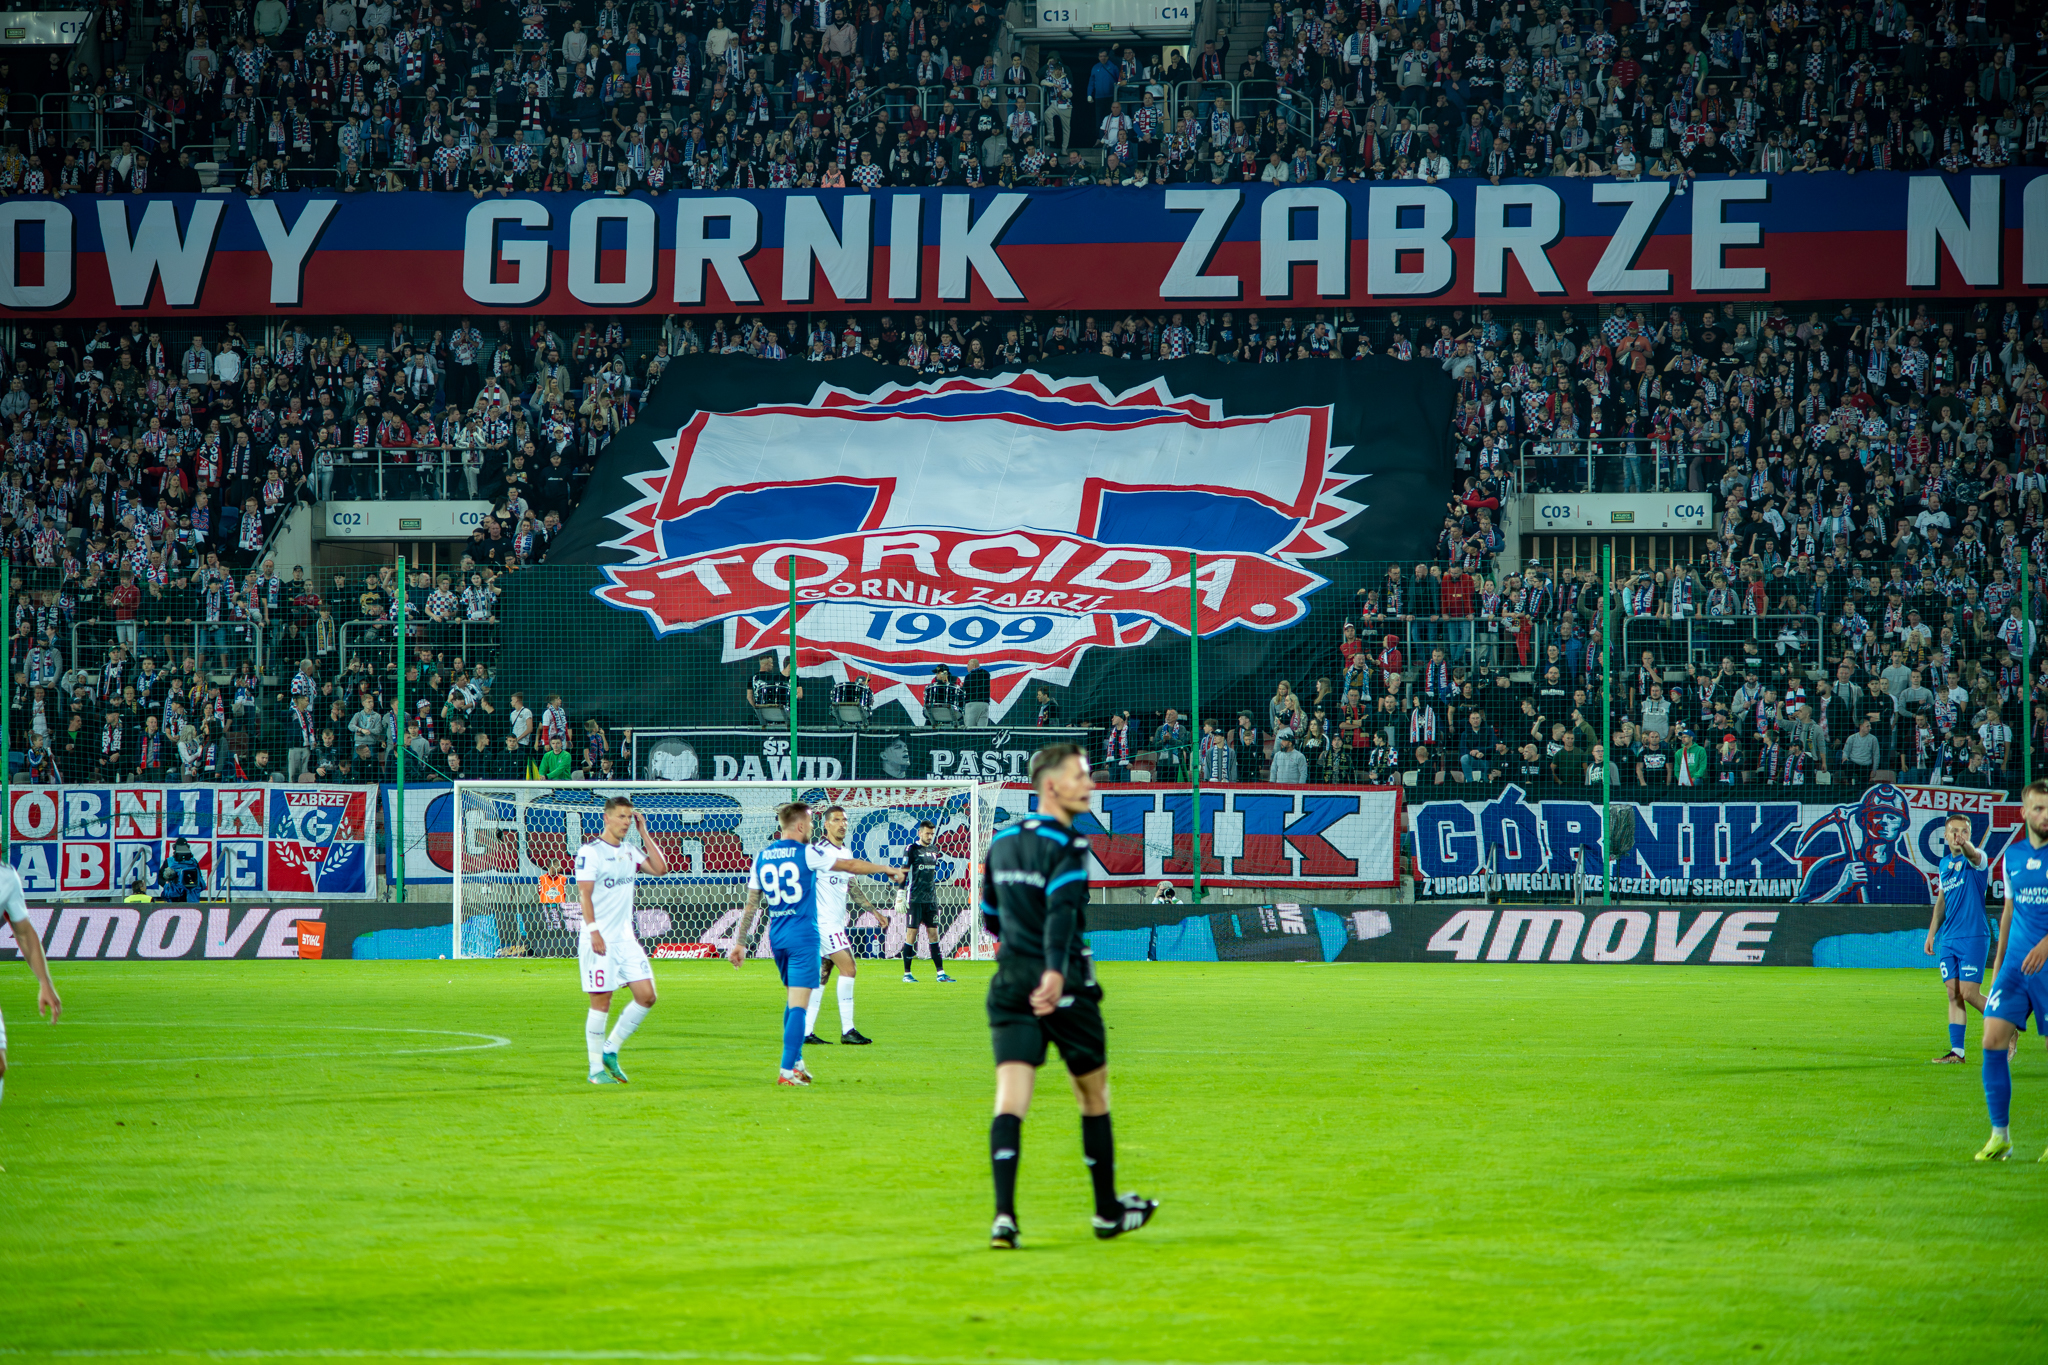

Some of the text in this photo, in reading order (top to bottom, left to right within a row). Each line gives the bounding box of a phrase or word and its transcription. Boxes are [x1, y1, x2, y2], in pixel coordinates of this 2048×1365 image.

[1043, 10, 1070, 22] C13
[1161, 7, 1189, 19] C14
[1158, 178, 1770, 300] ZABRZE
[1906, 173, 2048, 290] N
[333, 512, 361, 525] C02
[1541, 505, 1571, 518] C03
[1674, 504, 1705, 518] C04
[657, 532, 1238, 611] TORCIDA
[967, 586, 1114, 612] ZABRZE
[865, 610, 1054, 649] 1999
[713, 754, 843, 781] DAWID
[290, 793, 346, 807] ZABRZE
[1903, 788, 1993, 812] ZABRZE
[1415, 783, 1802, 881] GÓRNIK
[760, 861, 803, 906] 93
[1504, 872, 1562, 894] WĘGLA
[1692, 878, 1747, 897] SERCA
[1749, 878, 1801, 897] ZNANY
[301, 933, 321, 947] STIHL
[1426, 910, 1780, 962] 4MOVE
